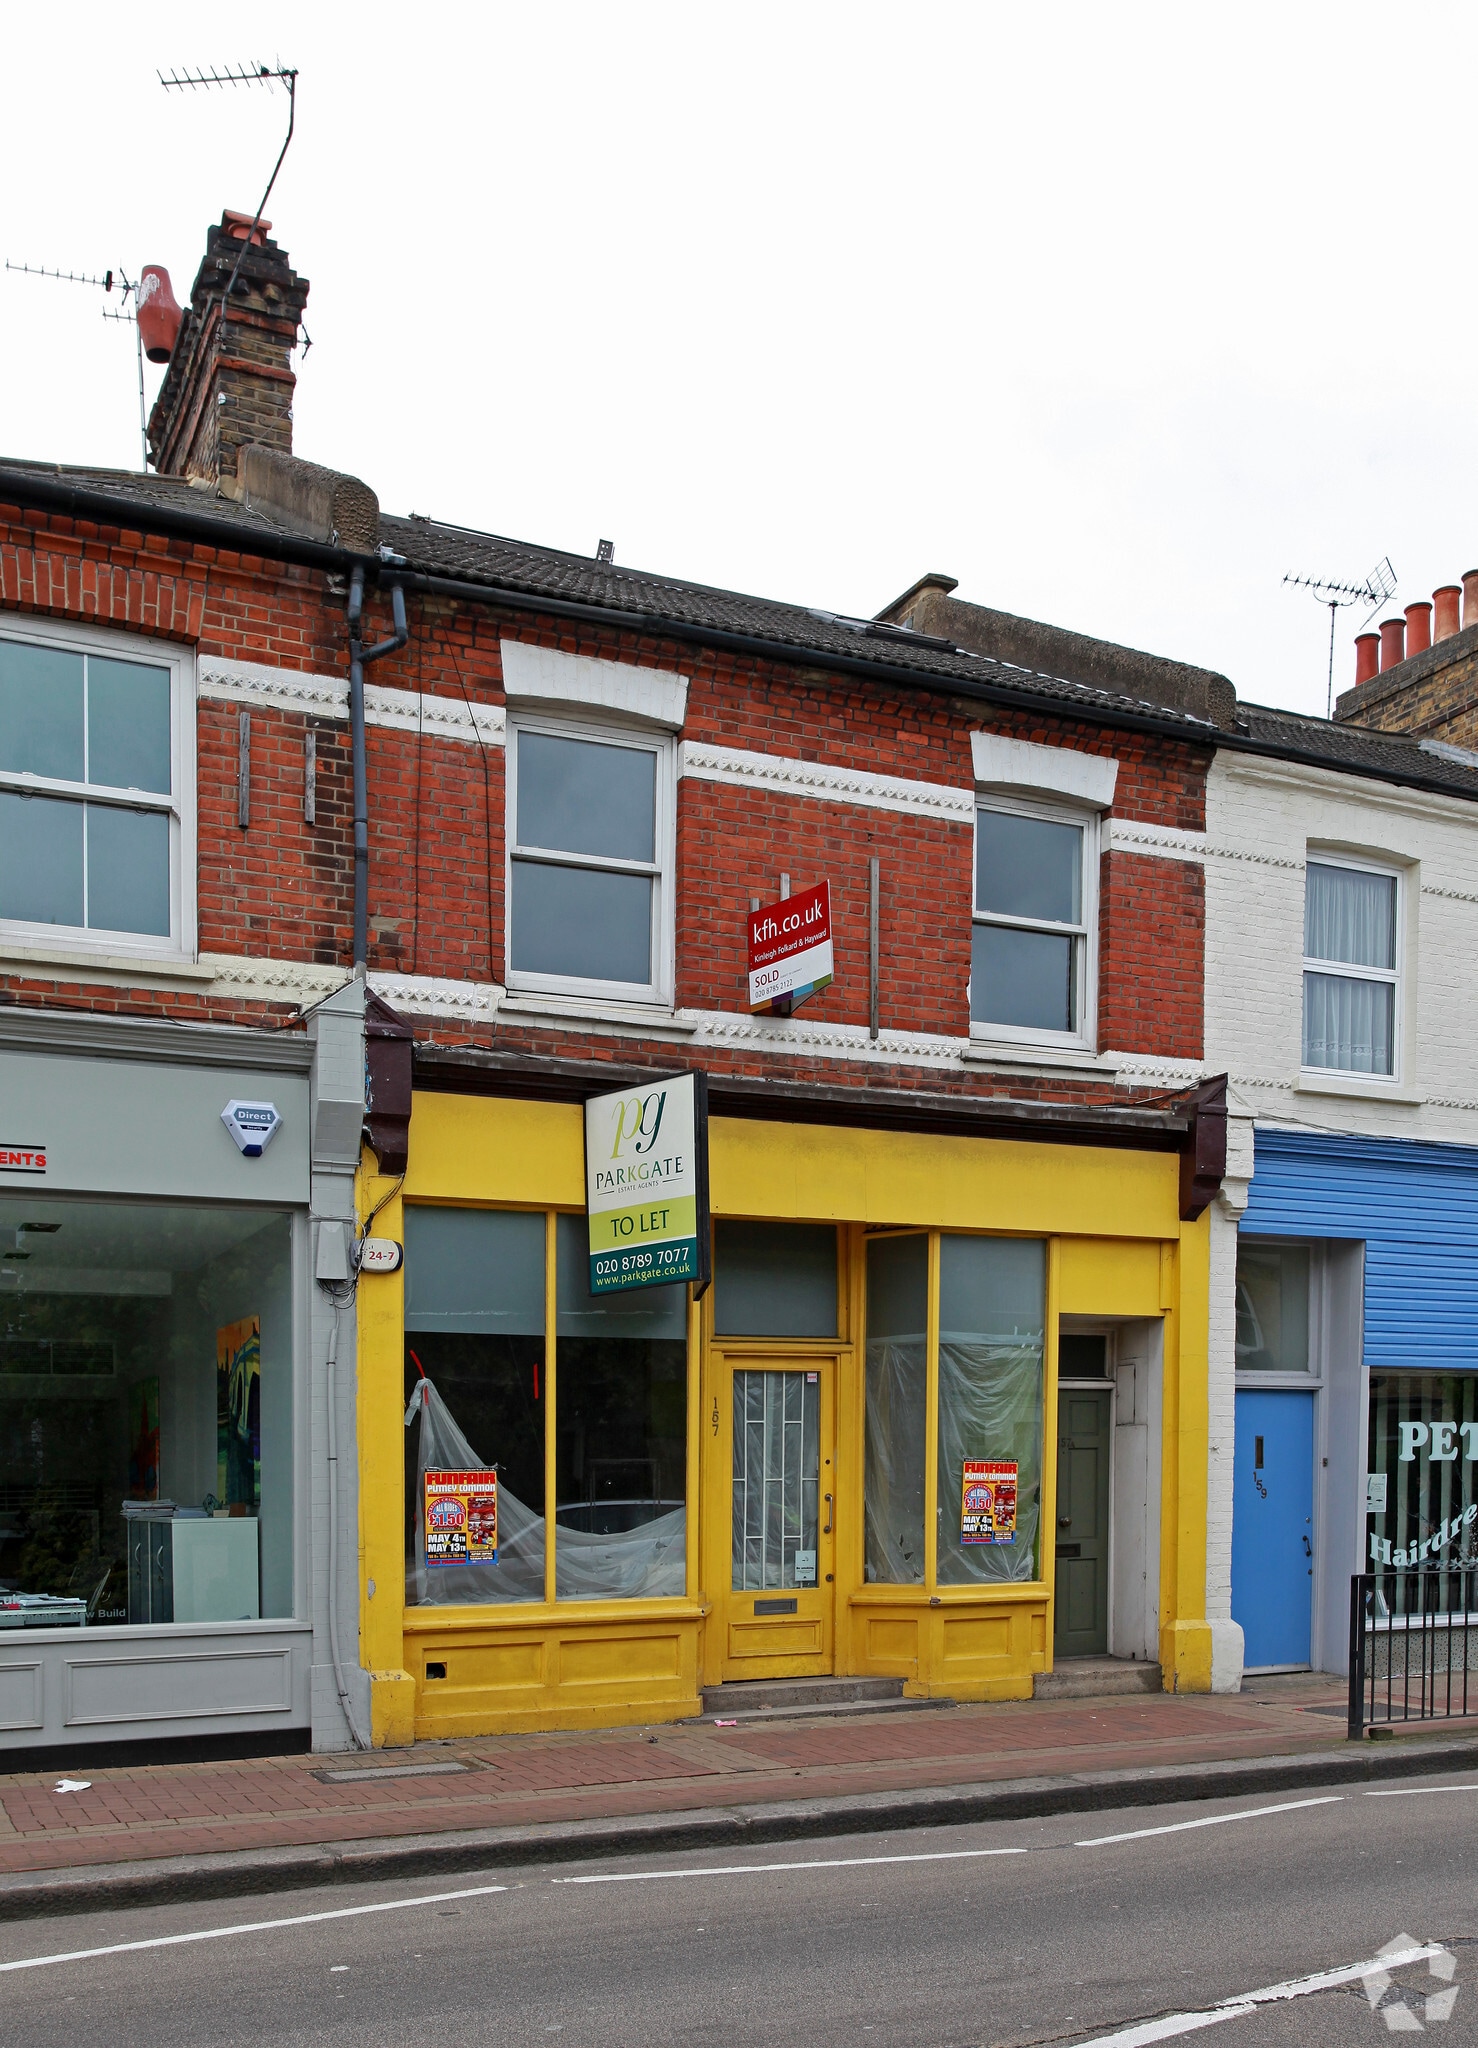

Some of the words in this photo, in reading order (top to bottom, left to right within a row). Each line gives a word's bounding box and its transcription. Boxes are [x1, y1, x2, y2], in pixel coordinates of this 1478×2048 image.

[753, 898, 823, 945] kfh.co.uk
[754, 948, 777, 963] Kinleigh
[778, 940, 798, 955] Folkard
[798, 938, 804, 947] &
[804, 928, 827, 945] Hayward
[755, 969, 779, 988] SOLD
[755, 989, 766, 999] 020
[780, 978, 793, 990] 2122
[238, 1111, 271, 1121] Direct
[596, 1156, 684, 1190] PARKGATE
[617, 1184, 636, 1194] ESTATE
[637, 1180, 659, 1189] AGENTS
[611, 1216, 634, 1238] TO
[640, 1209, 669, 1233] LET
[368, 1251, 395, 1261] 24-7
[596, 1258, 618, 1275] 020
[622, 1253, 652, 1271] 8789
[657, 1247, 689, 1265] 7077
[596, 1262, 691, 1286] www.parkgate.co.uk
[965, 1463, 1017, 1473] FUNFAIR
[427, 1472, 496, 1485] FUNFAIR
[1253, 1471, 1267, 1499] 159
[427, 1484, 457, 1493] PUTNEY
[459, 1484, 496, 1492] COMMON
[965, 1497, 992, 1510] £1.50
[428, 1512, 466, 1527] £1.50
[963, 1515, 980, 1523] MAY
[963, 1524, 979, 1532] MAY
[428, 1534, 450, 1543] MAY
[1369, 1503, 1478, 1568] Hairdre
[428, 1544, 449, 1553] MAY
[98, 1608, 126, 1618] Build
